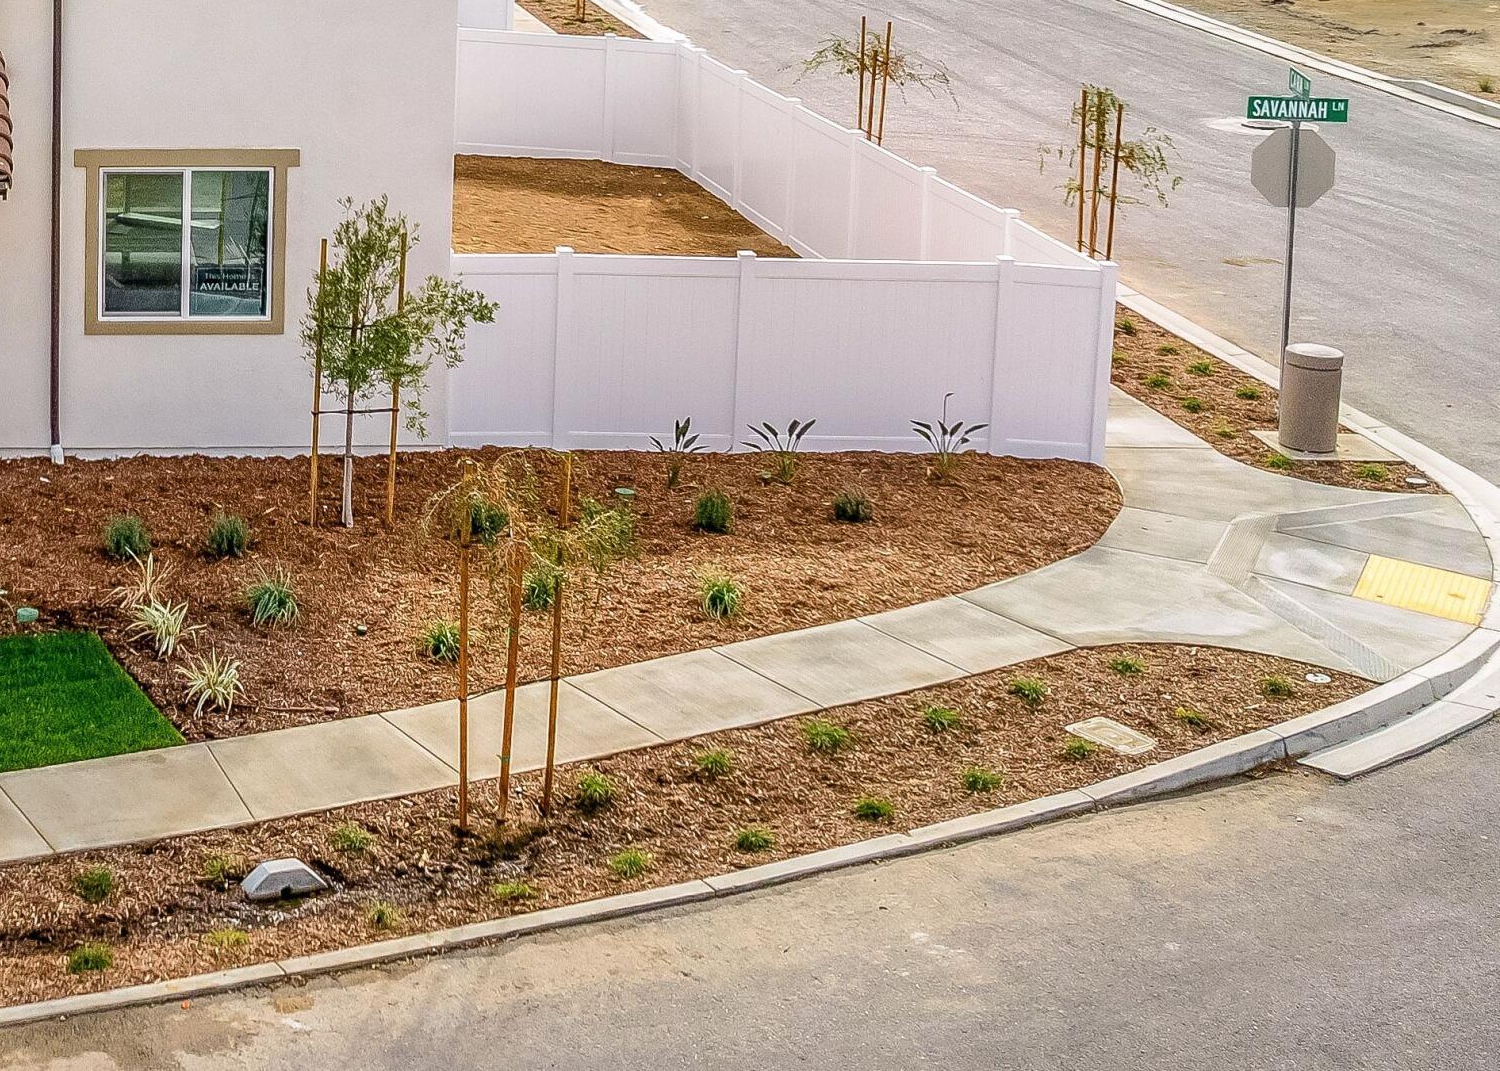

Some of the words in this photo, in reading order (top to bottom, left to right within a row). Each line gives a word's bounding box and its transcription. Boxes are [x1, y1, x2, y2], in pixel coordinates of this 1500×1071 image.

[1252, 99, 1328, 119] SAVANNAH
[1332, 101, 1345, 112] LN
[199, 281, 260, 291] AVAILABLE
